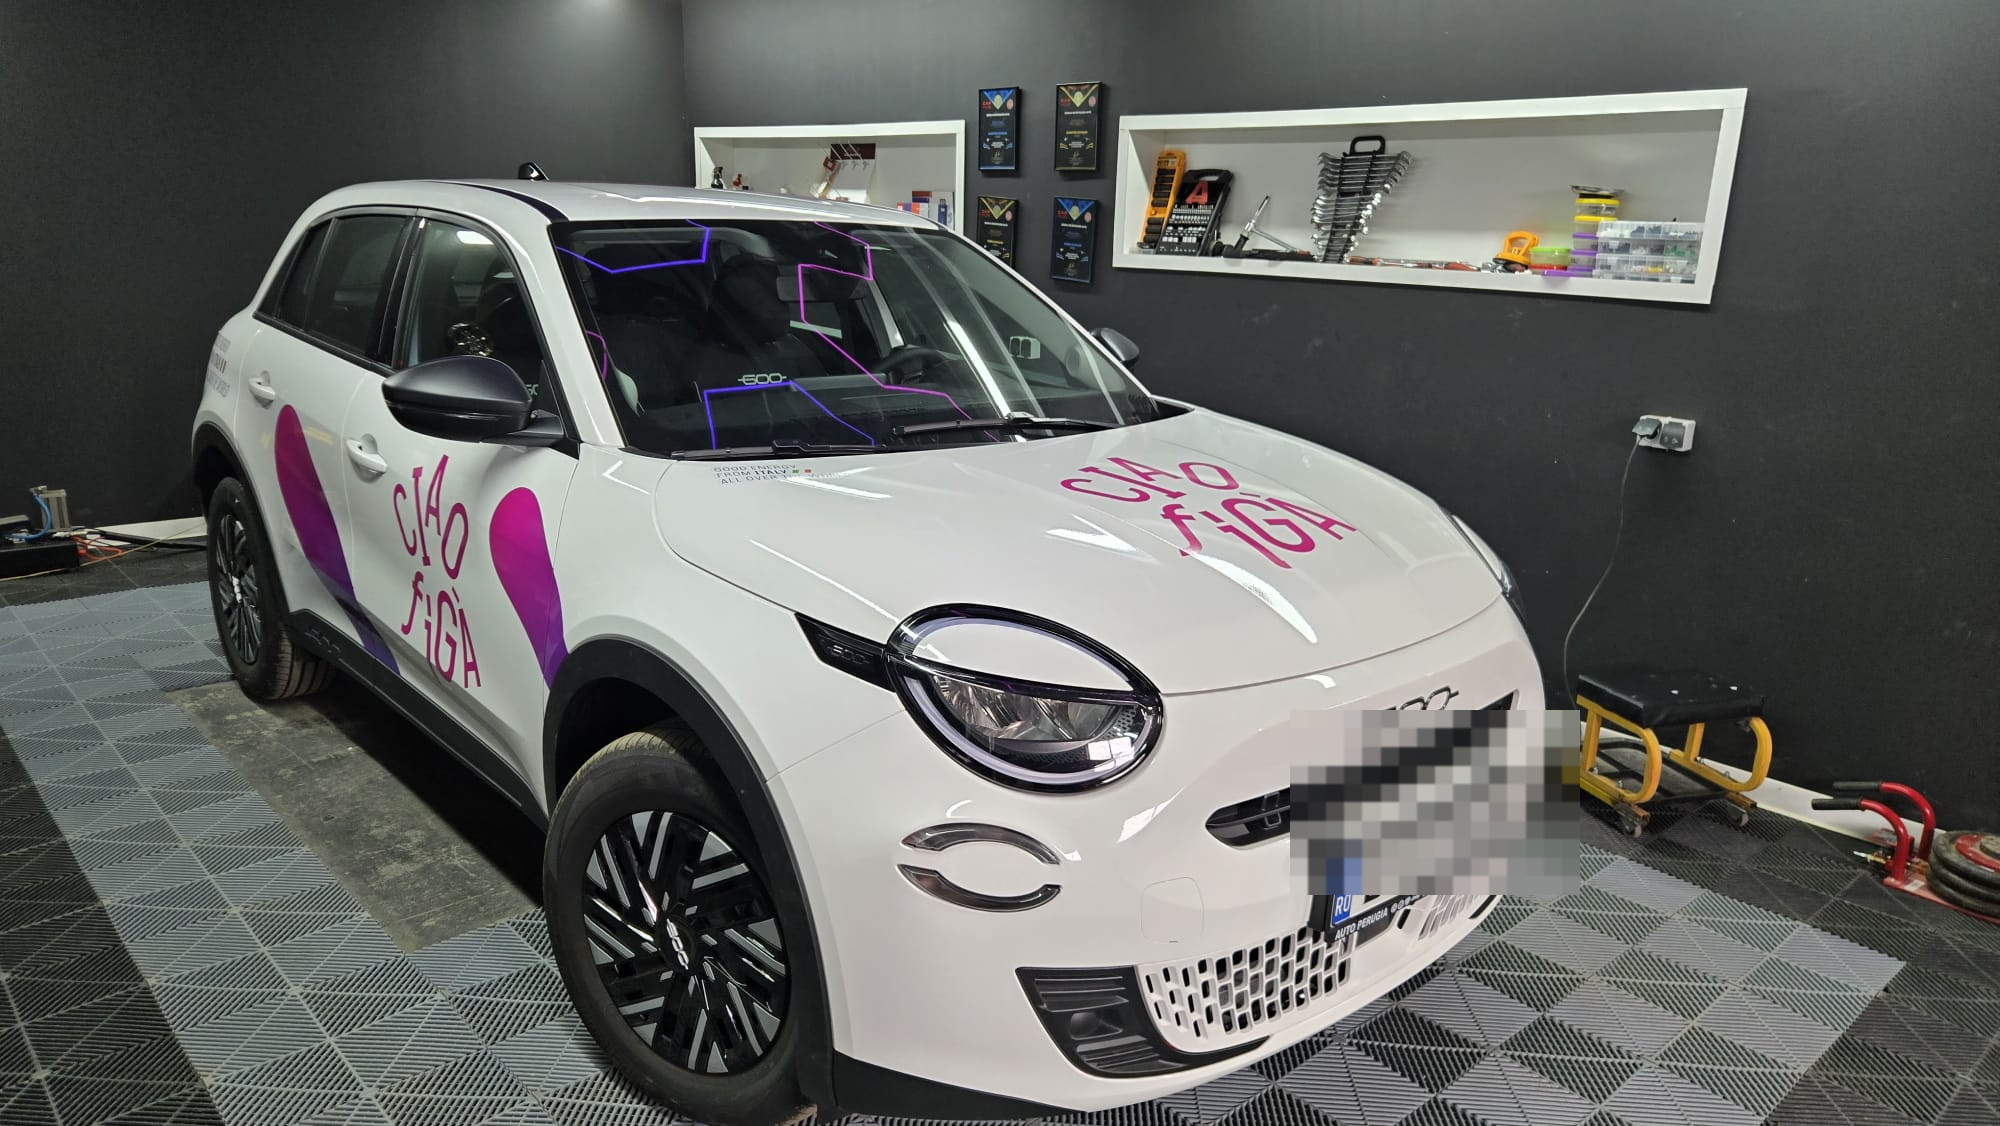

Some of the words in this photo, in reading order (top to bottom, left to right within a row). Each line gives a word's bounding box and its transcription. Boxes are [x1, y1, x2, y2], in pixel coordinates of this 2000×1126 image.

[716, 471, 751, 479] FROM
[721, 477, 742, 485] ALL
[1060, 457, 1239, 503] CIAO
[393, 454, 469, 580] CIAO
[1335, 895, 1351, 917] RO
[1335, 921, 1357, 940] AUTO
[1357, 907, 1388, 930] PERUGIA
